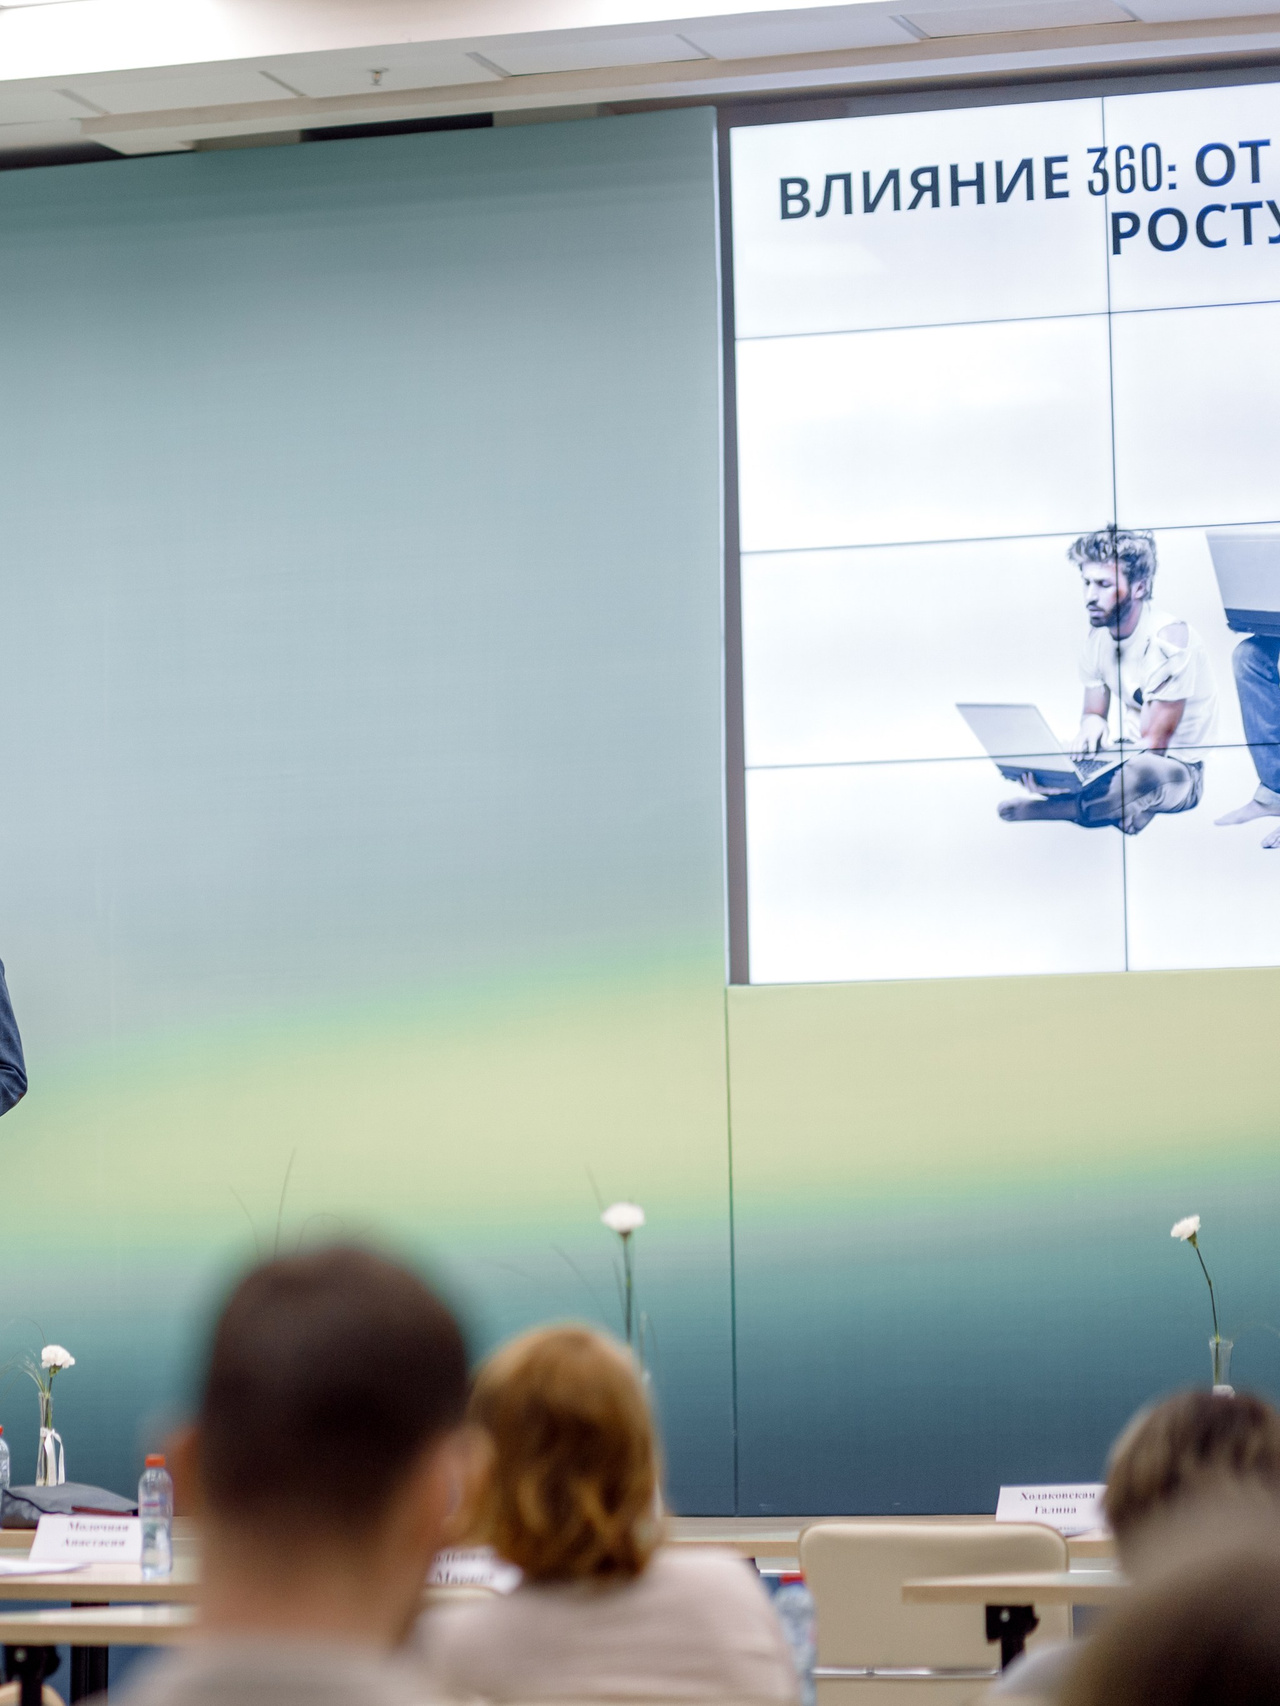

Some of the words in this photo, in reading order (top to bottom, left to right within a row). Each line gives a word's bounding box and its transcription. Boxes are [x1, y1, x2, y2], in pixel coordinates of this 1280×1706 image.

[779, 155, 1070, 221] ВЛИЯНИЕ
[1086, 141, 1177, 197] 360:
[1194, 138, 1271, 188] ОТ
[1034, 1505, 1077, 1515] Галина
